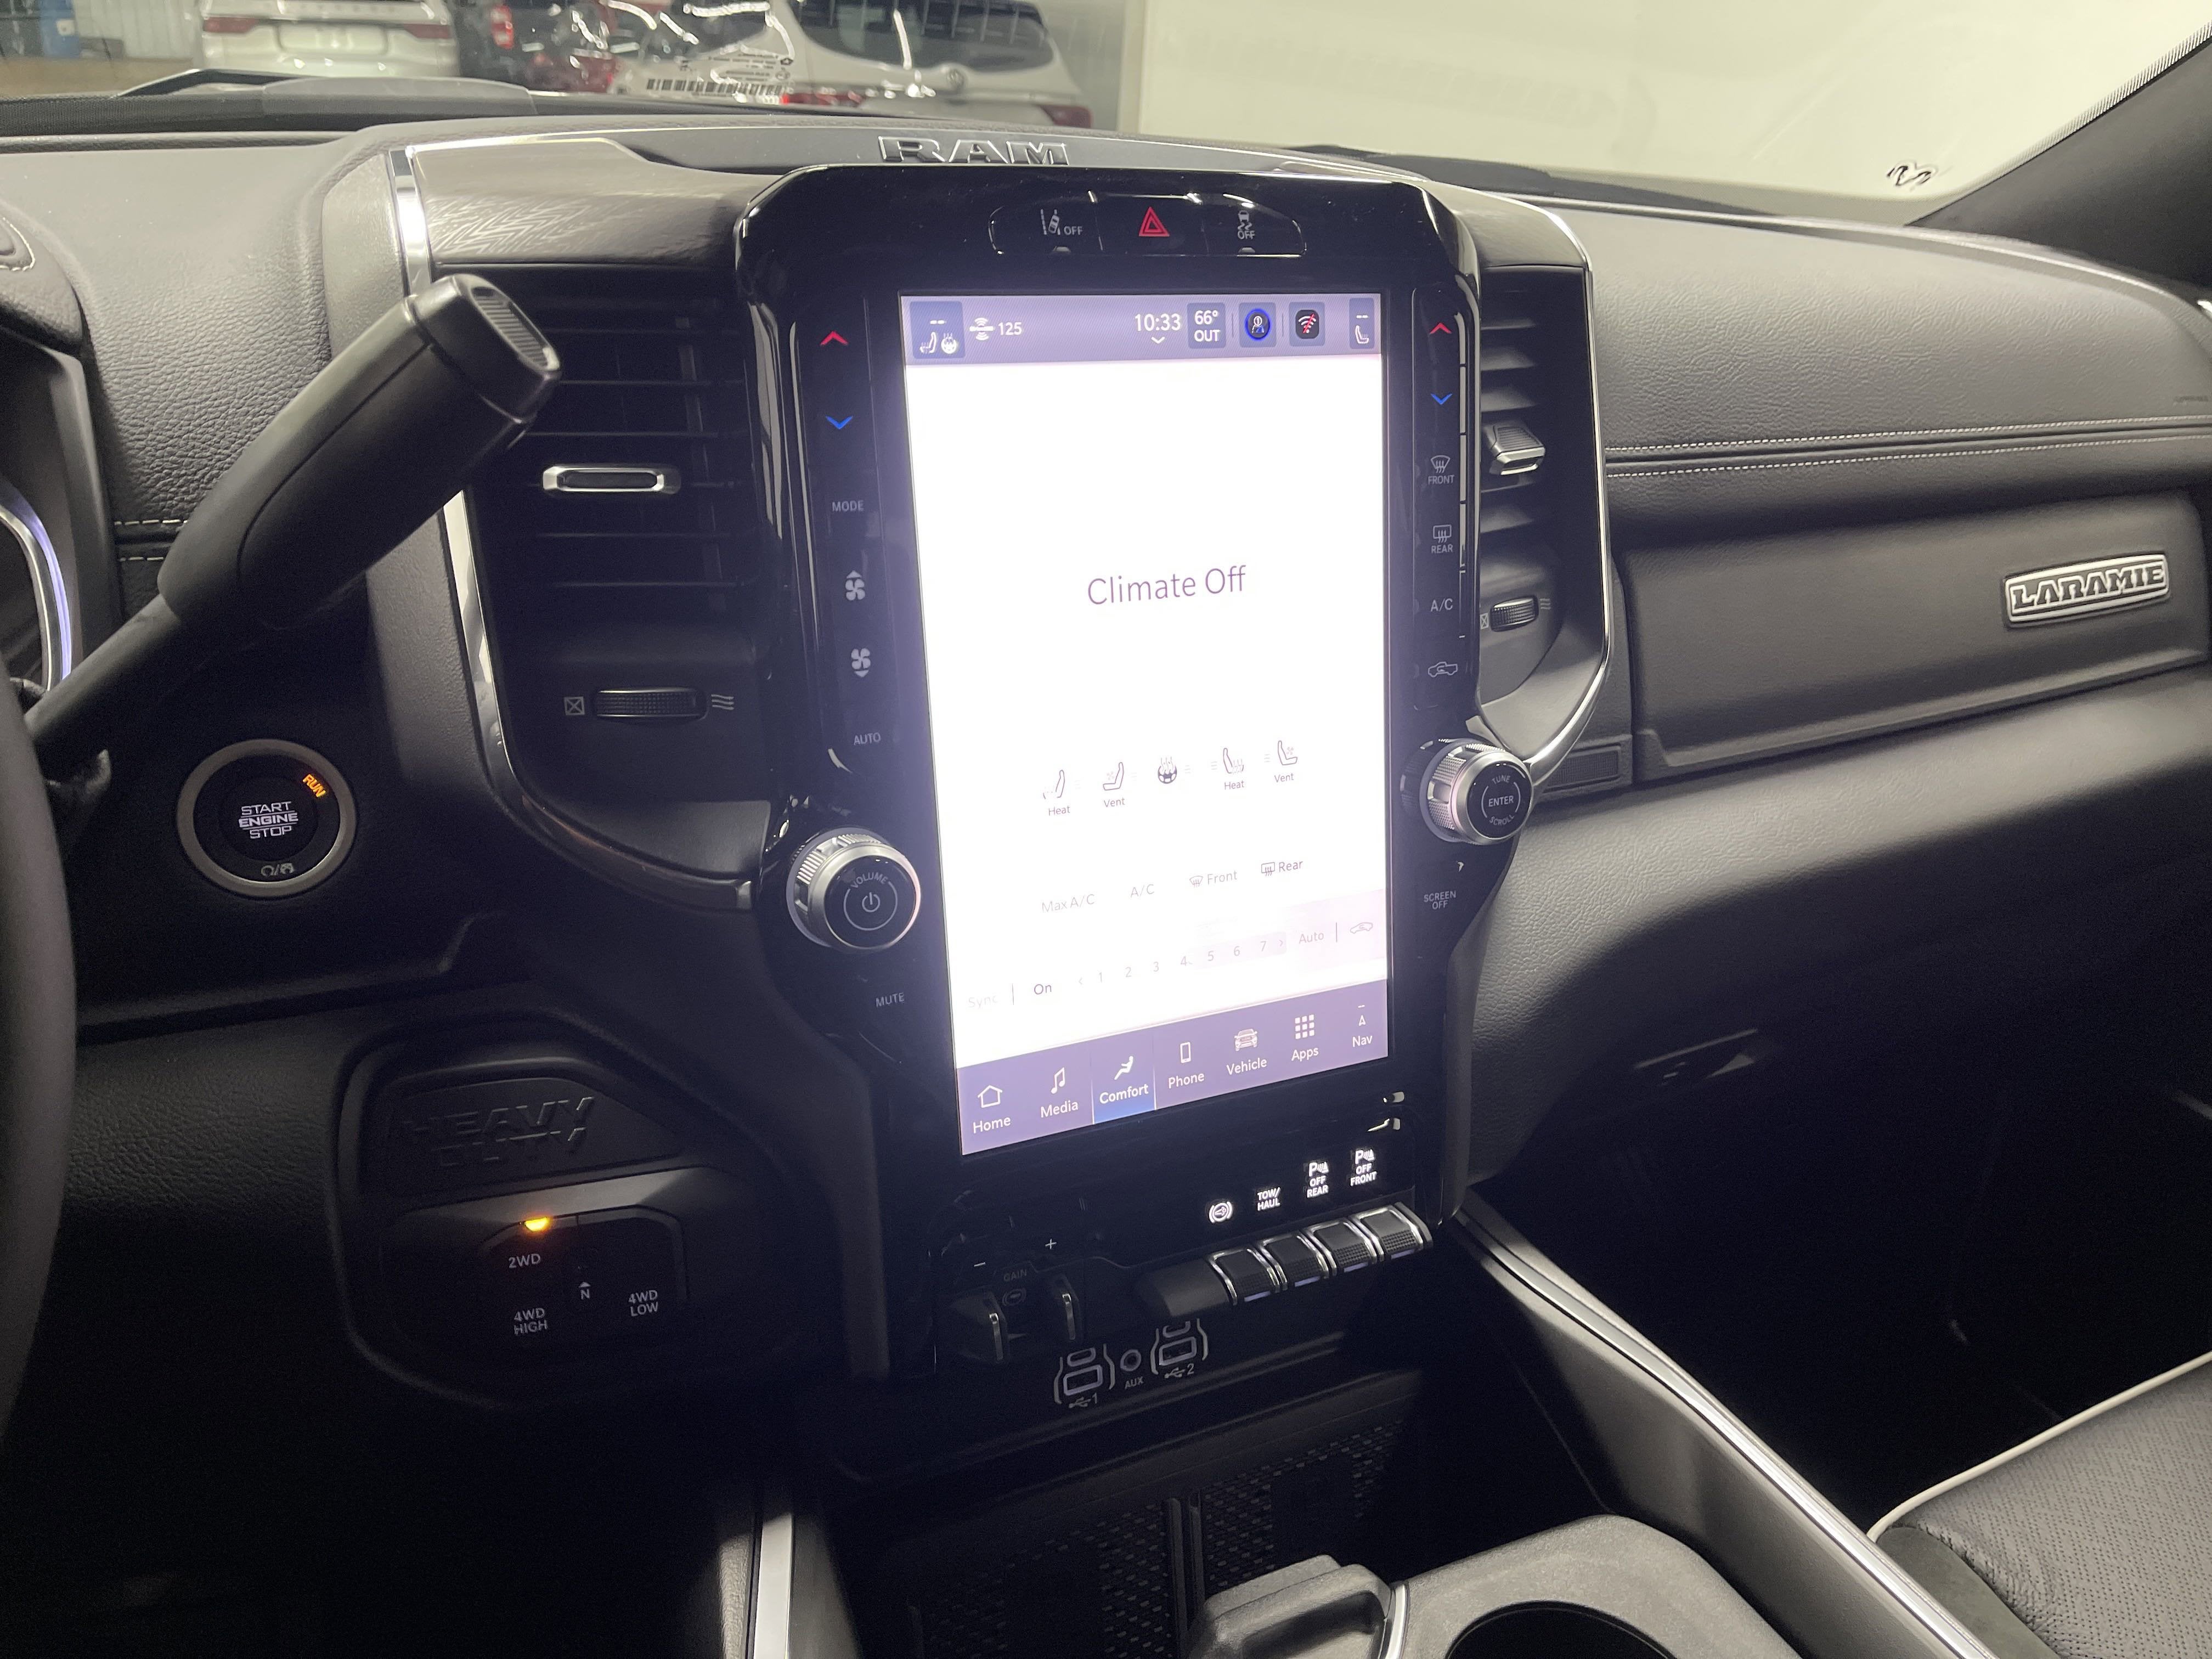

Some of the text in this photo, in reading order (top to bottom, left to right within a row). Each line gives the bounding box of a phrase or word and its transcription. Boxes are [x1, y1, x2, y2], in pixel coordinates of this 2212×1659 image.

[878, 136, 1070, 165] RAM
[1063, 226, 1083, 236] OFF
[1237, 230, 1255, 240] OFF
[1134, 313, 1181, 331] 10:33
[1194, 309, 1218, 325] 66°
[998, 322, 1023, 336] 125
[1194, 329, 1220, 342] OUT
[1428, 475, 1454, 484] FRONT
[832, 500, 864, 512] MODE
[1431, 544, 1453, 554] REAR
[1088, 565, 1246, 605] Climate Off
[2010, 560, 2166, 614] LARAMIE
[1430, 599, 1453, 612] A/C
[854, 732, 881, 745] AUTO
[1274, 772, 1295, 783] Vent
[1492, 774, 1511, 785] TUNE
[302, 774, 326, 798] RUN
[1224, 779, 1245, 791] Heat
[1103, 797, 1125, 808] Vent
[1488, 795, 1514, 807] ENTER
[241, 801, 292, 816] START
[1048, 805, 1071, 816] Heat
[238, 812, 298, 828] ENGINE
[1489, 814, 1514, 826] SCROLL
[250, 825, 292, 839] STOP
[1278, 860, 1304, 873] Rear
[850, 871, 888, 889] VOLUME
[1207, 870, 1238, 885] Front
[1130, 884, 1155, 898] A/C
[1424, 890, 1456, 903] SCREEN
[1041, 894, 1095, 913] Max A/C
[1432, 900, 1448, 910] OFF
[1298, 932, 1325, 944] Auto
[1098, 941, 1267, 983] 1 2 3 4 5 6 7
[1034, 984, 1052, 995] On
[876, 992, 905, 1008] MUTE
[1352, 1035, 1373, 1048] Nav
[1291, 1046, 1319, 1063] Apps
[1226, 1057, 1268, 1075] Vehicle
[1168, 1072, 1205, 1089] Phone
[1099, 1083, 1149, 1105] Comfort
[1040, 1099, 1079, 1118] Media
[972, 1116, 1011, 1134] Home
[1356, 1163, 1372, 1175] OFF
[1309, 1175, 1326, 1187] OFF
[1350, 1171, 1377, 1187] FRONT
[1257, 1187, 1282, 1201] TOW/
[1307, 1184, 1329, 1198] REAR
[1257, 1198, 1280, 1211] HAUL
[509, 1253, 541, 1269] 2WD
[1003, 1269, 1028, 1282] GAIN
[580, 1289, 590, 1300] N
[629, 1289, 658, 1304] 4WD
[514, 1307, 545, 1322] 4WD
[630, 1302, 659, 1317] LOW
[514, 1319, 549, 1336] HIGH
[1186, 1363, 1195, 1375] 2
[1124, 1376, 1144, 1390] AUX
